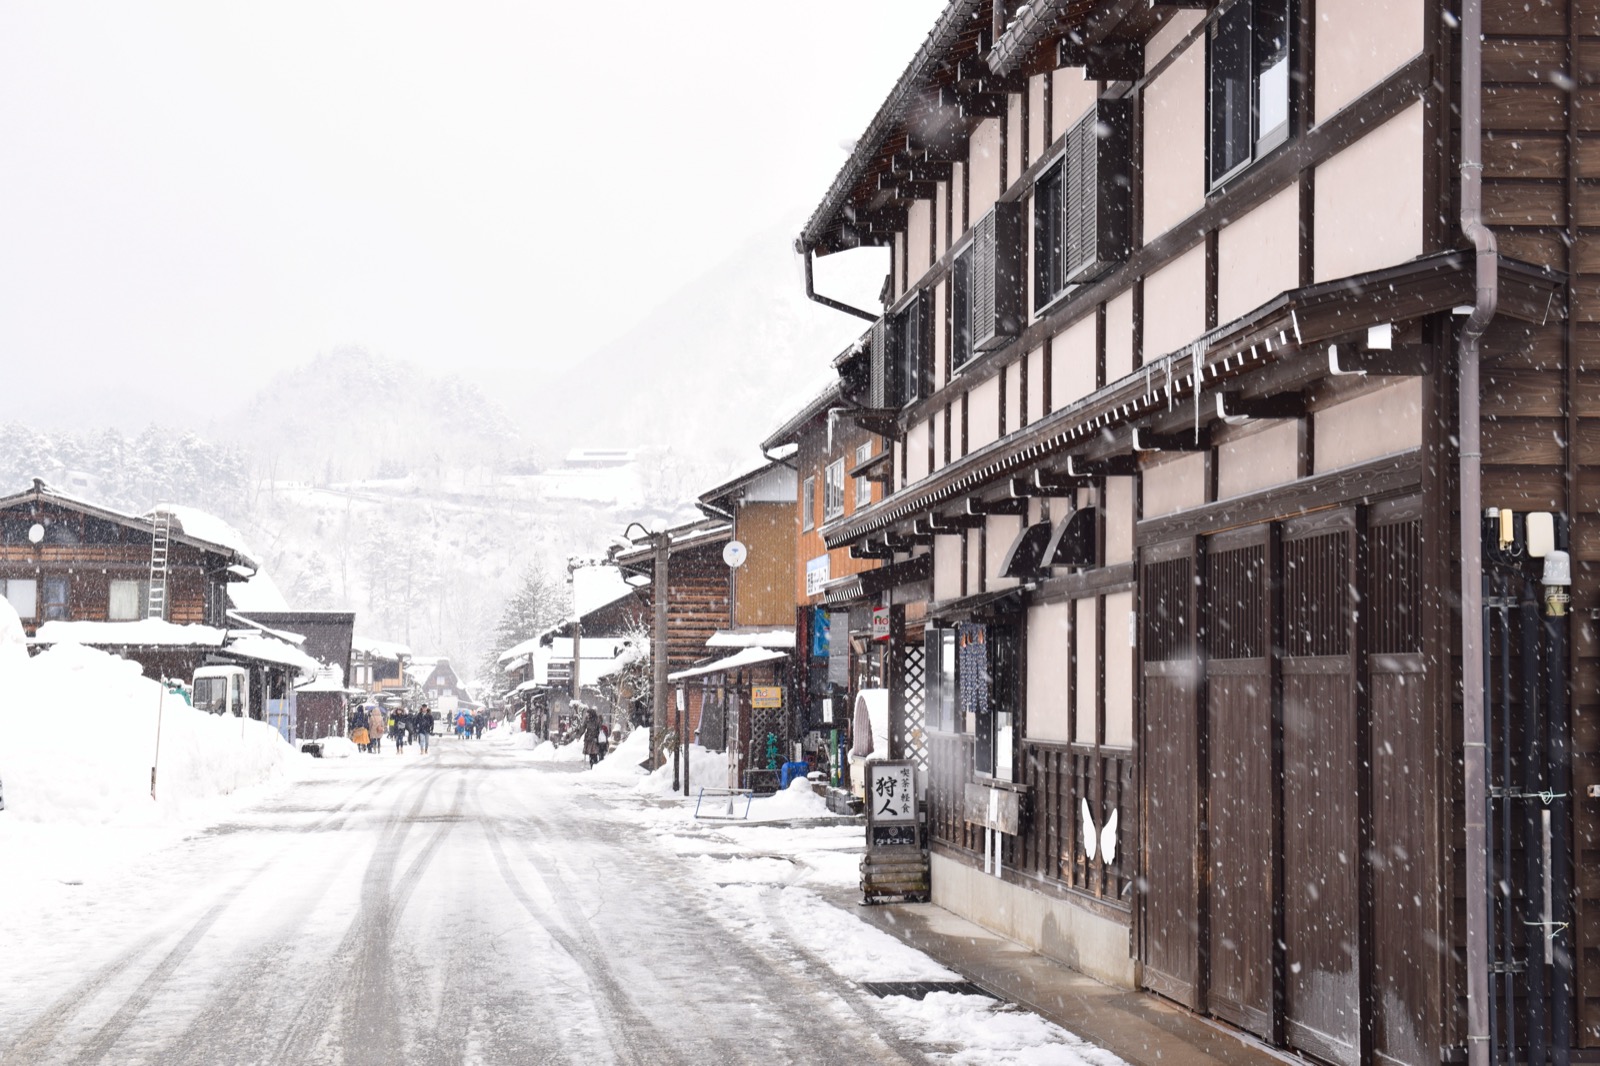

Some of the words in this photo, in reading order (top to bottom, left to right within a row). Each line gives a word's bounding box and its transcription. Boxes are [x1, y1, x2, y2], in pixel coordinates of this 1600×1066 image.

[875, 776, 898, 816] 狩人
[900, 768, 911, 814] 喫茶・軽食
